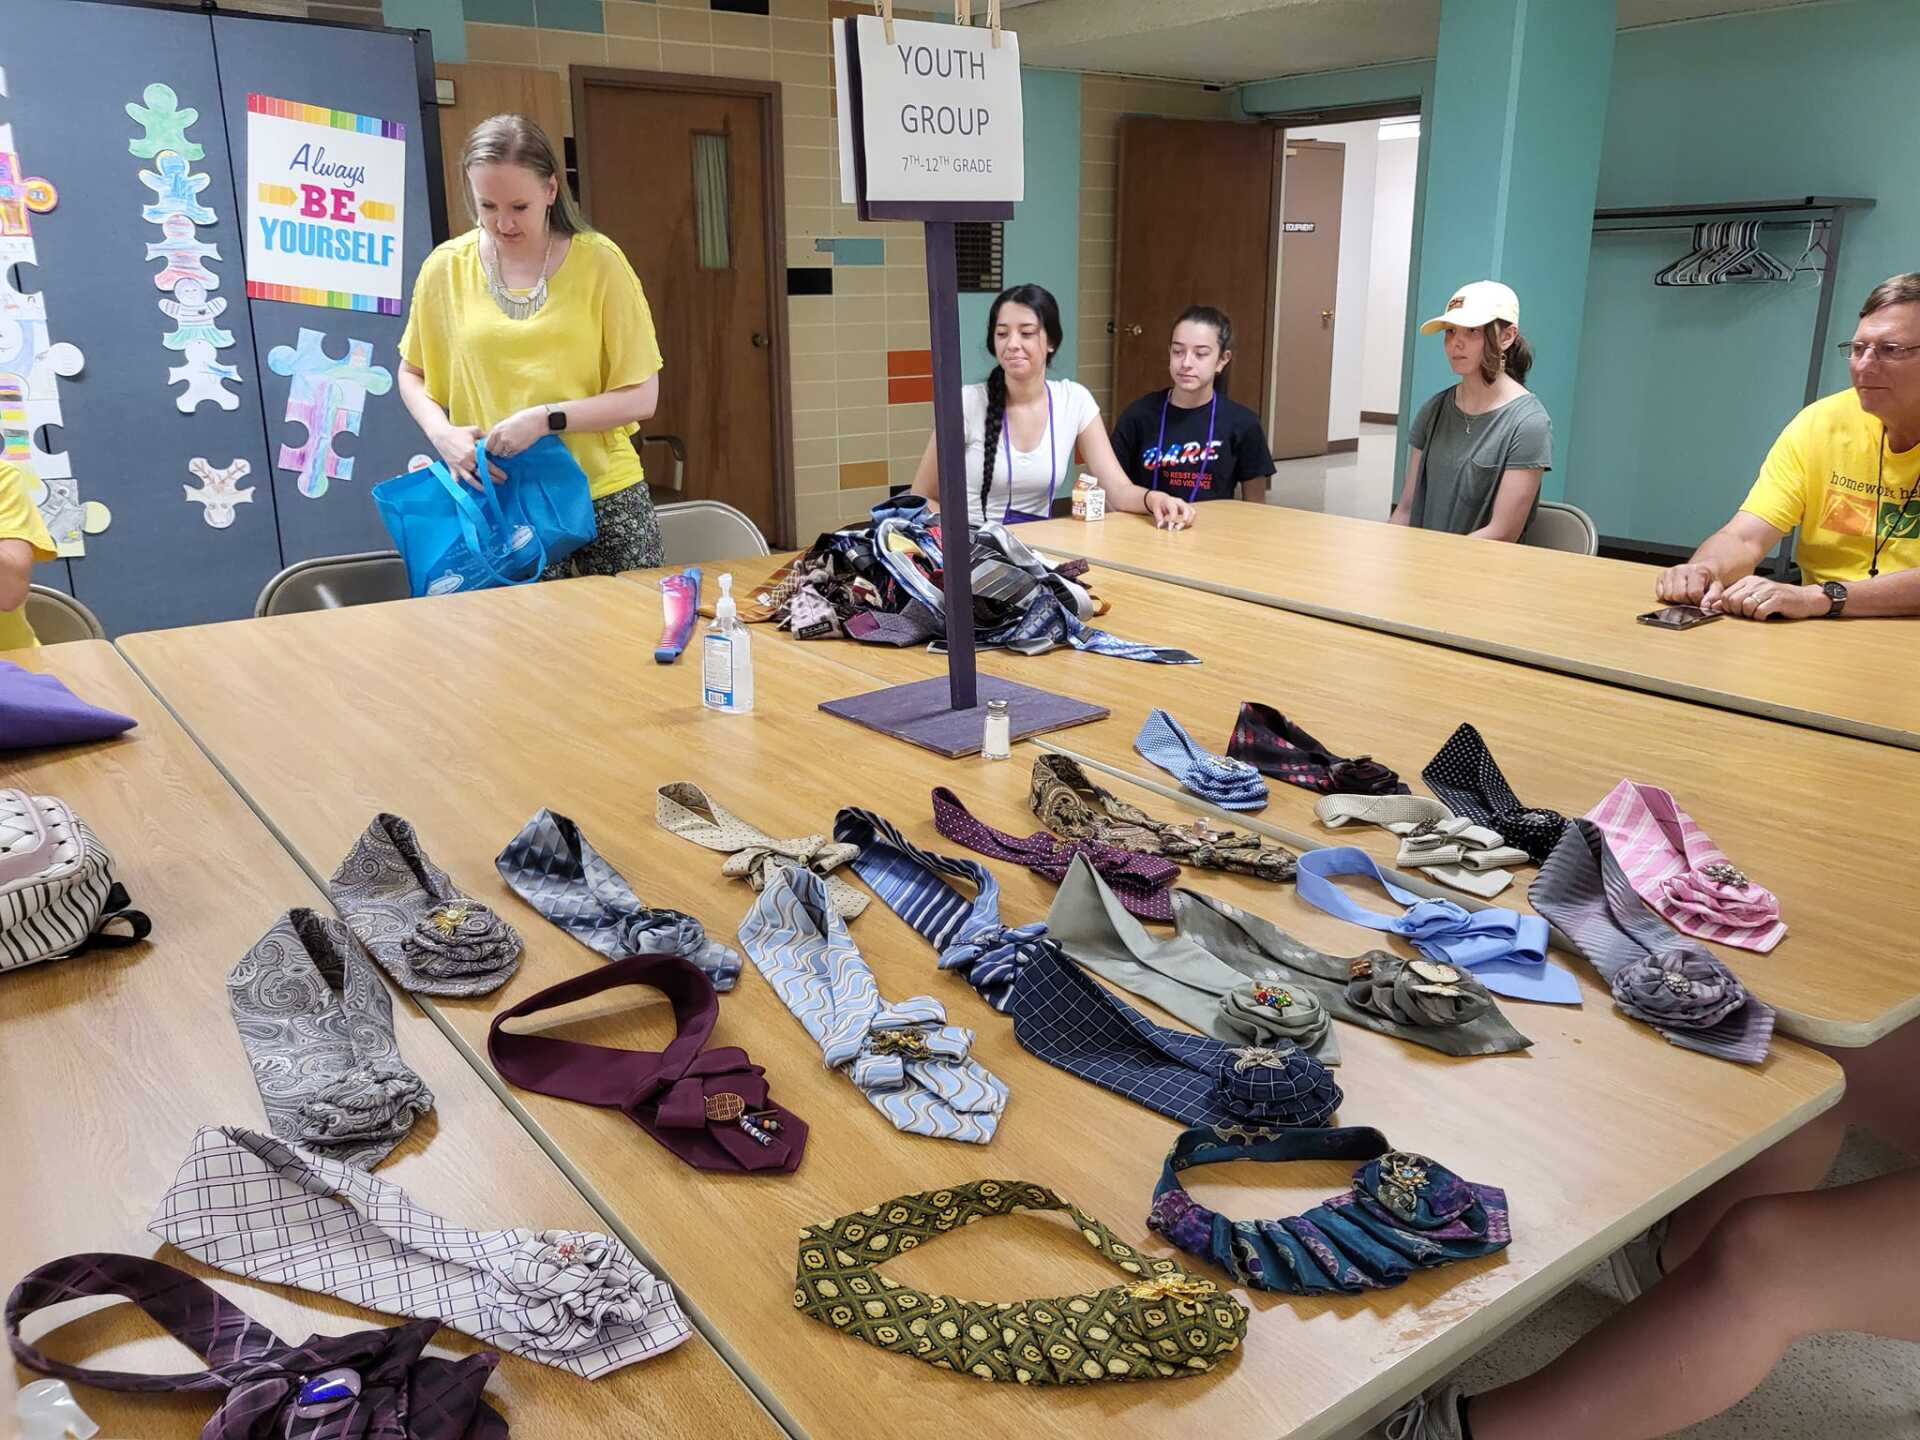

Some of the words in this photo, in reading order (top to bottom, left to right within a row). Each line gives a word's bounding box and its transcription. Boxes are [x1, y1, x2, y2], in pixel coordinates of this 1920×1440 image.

[897, 44, 985, 80] YOUTH
[901, 104, 990, 136] GROUP
[288, 143, 366, 188] Always
[953, 158, 993, 173] GRADE
[300, 183, 356, 223] BE
[259, 216, 396, 267] YOURSELF
[1183, 480, 1212, 489] VIOLNCE
[1191, 472, 1213, 481] DRGS
[1900, 487, 1920, 499] he
